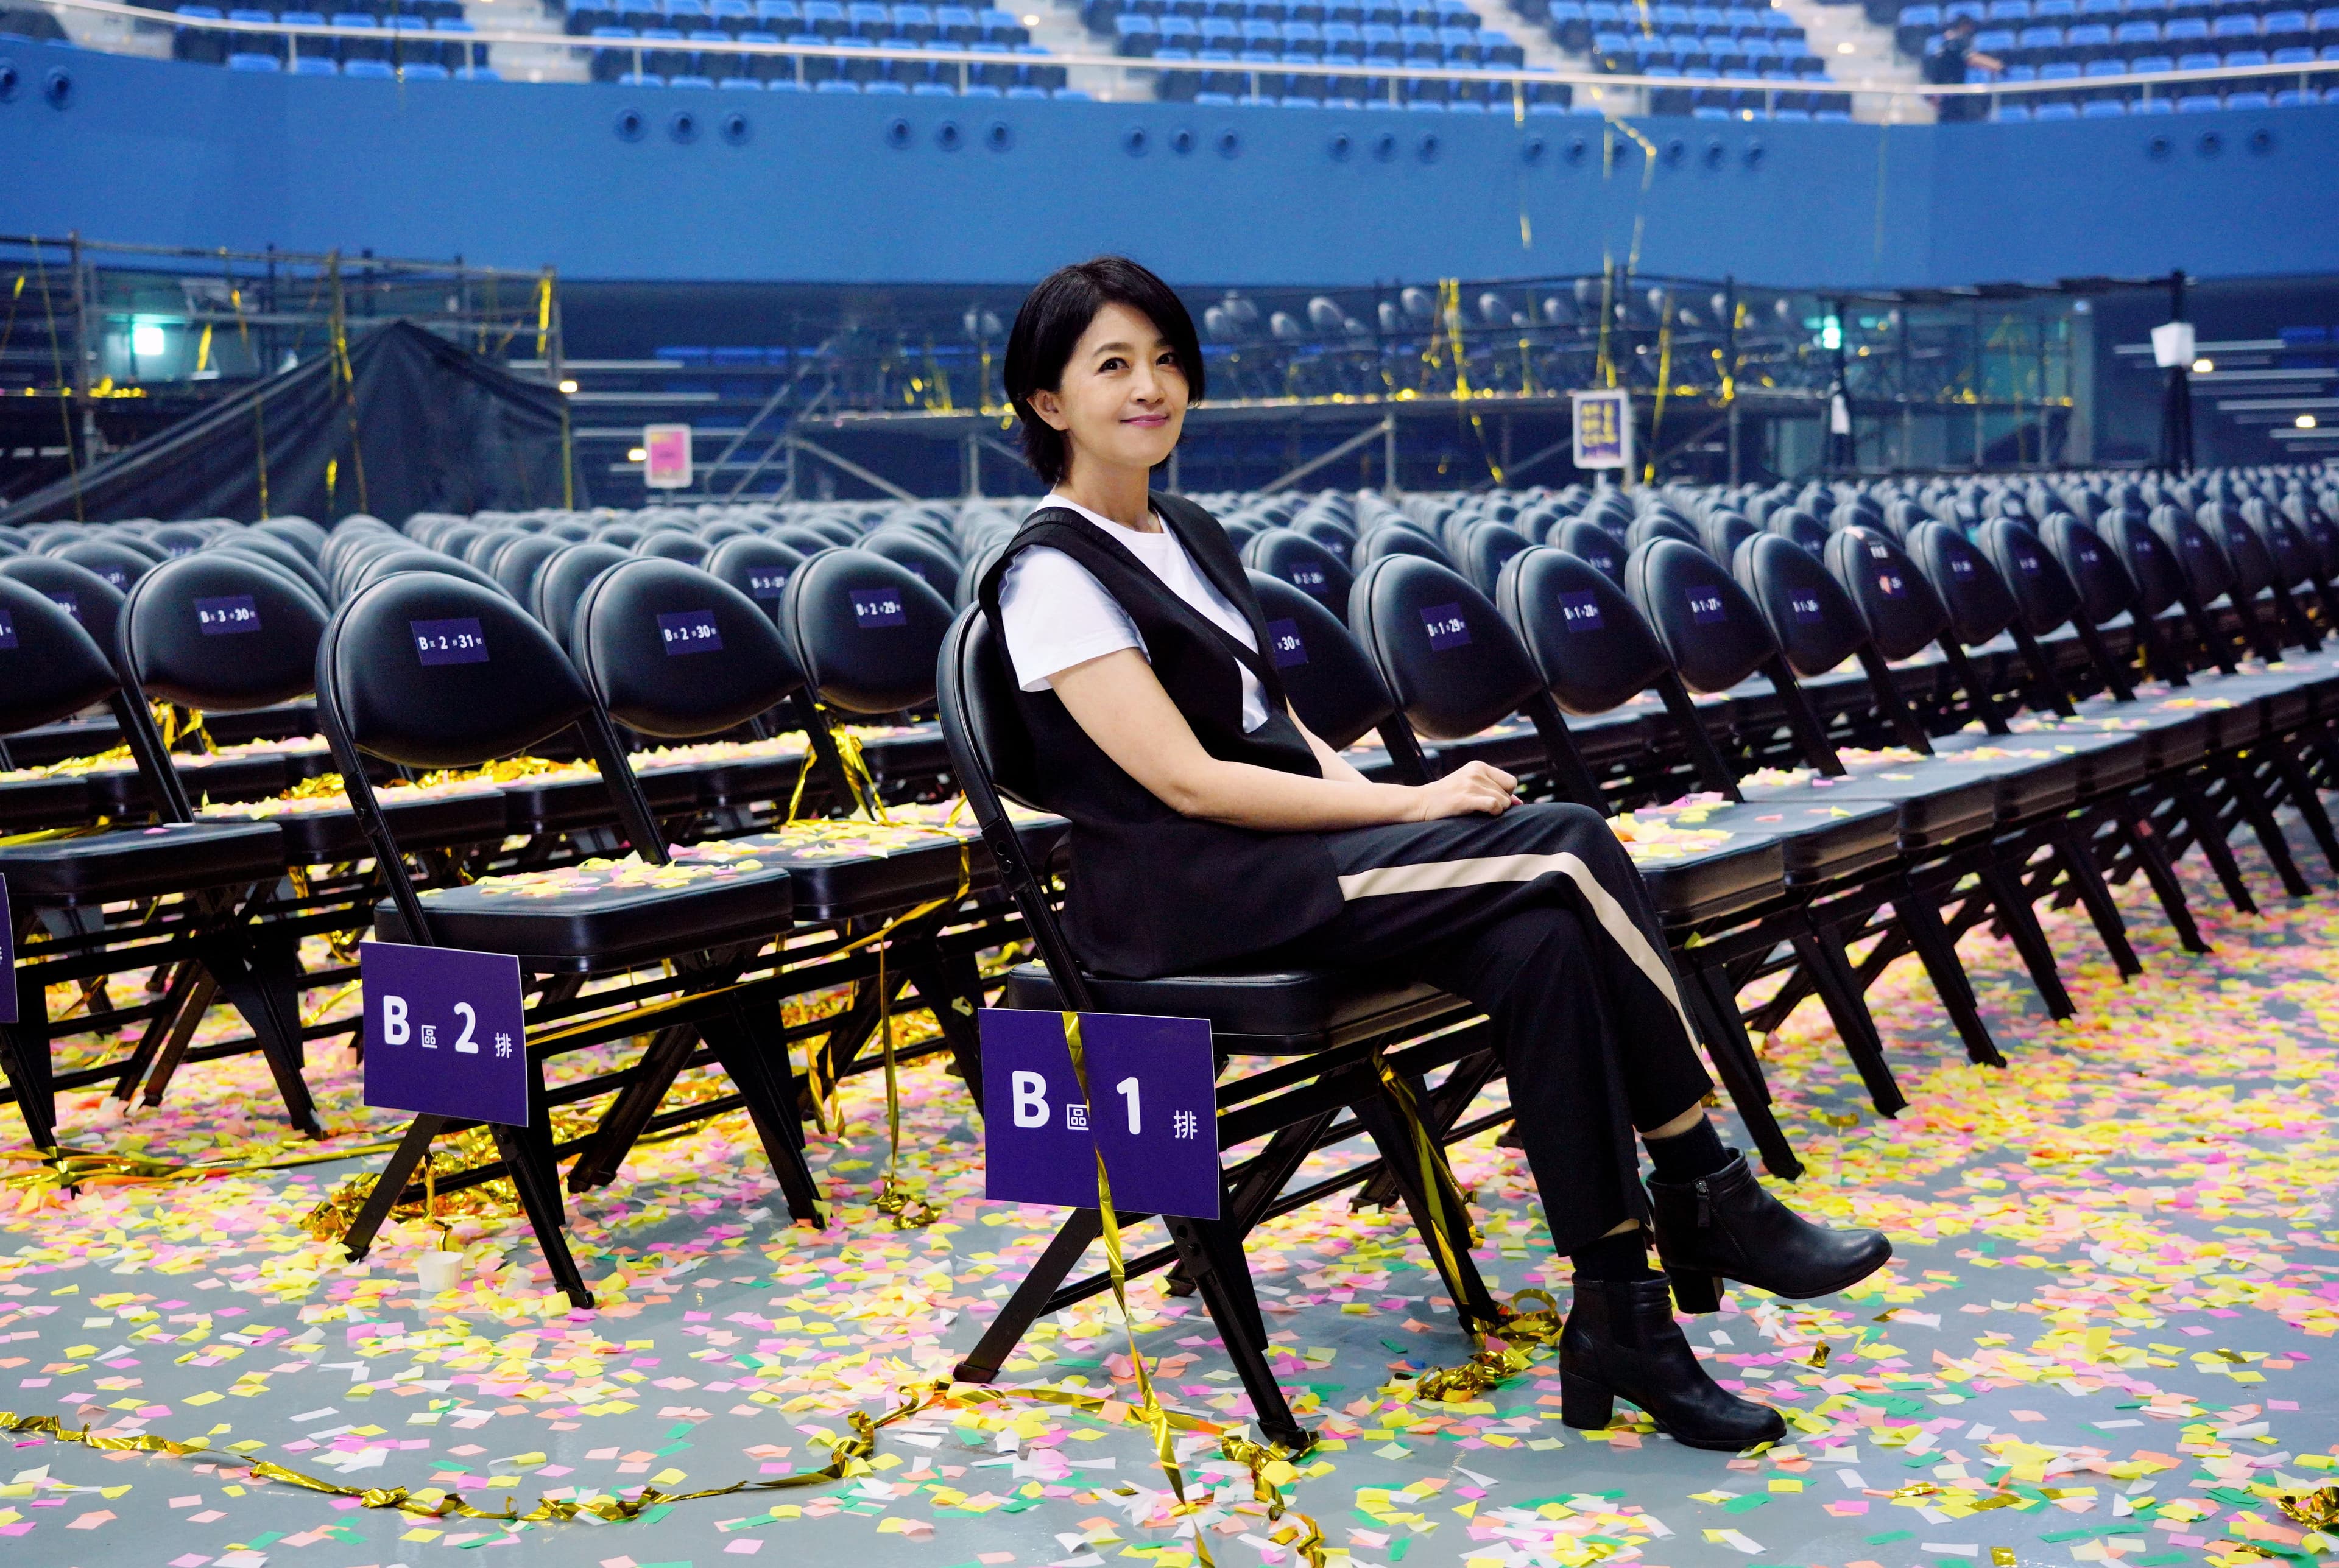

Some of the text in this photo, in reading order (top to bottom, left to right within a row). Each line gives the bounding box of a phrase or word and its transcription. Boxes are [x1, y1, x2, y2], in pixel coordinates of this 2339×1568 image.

[418, 636, 429, 650] B
[439, 636, 448, 650] 2
[458, 634, 474, 649] 31
[664, 628, 673, 642] B
[680, 627, 690, 641] 2
[696, 625, 711, 639] 30
[1281, 635, 1296, 651] 30
[383, 994, 513, 1059] B 區 2 排
[1012, 1070, 1198, 1140] B 區 1 排
